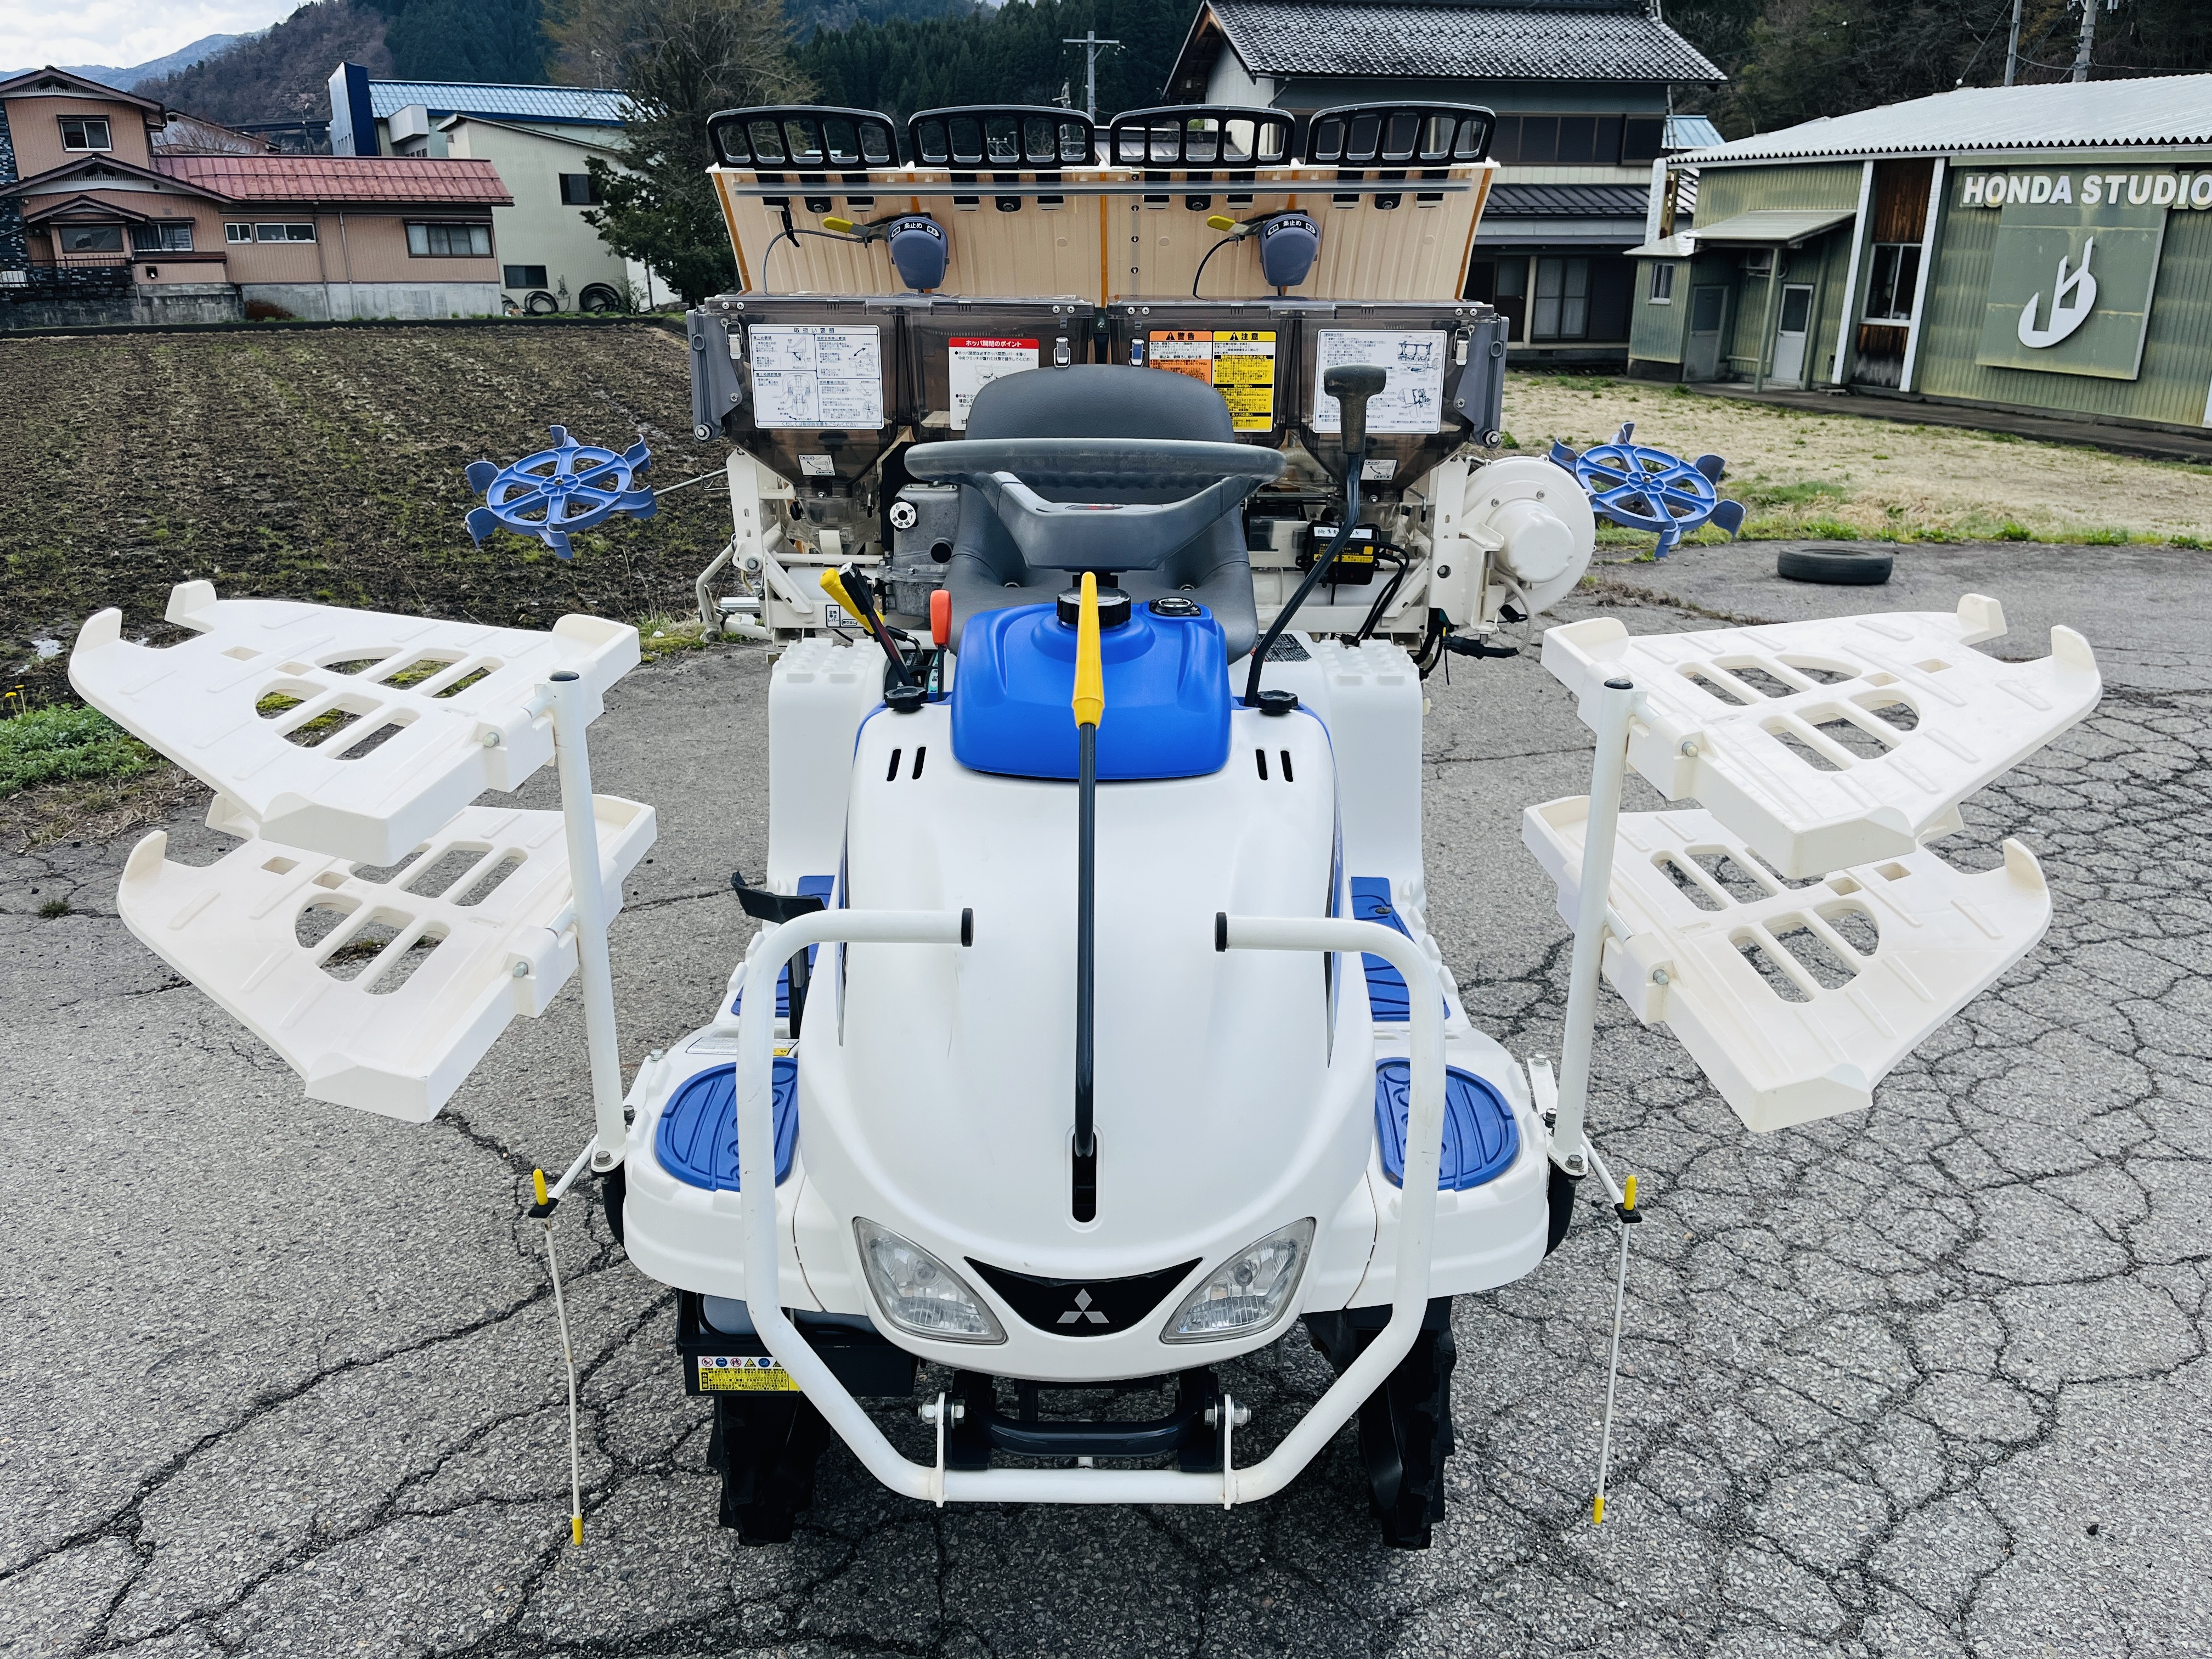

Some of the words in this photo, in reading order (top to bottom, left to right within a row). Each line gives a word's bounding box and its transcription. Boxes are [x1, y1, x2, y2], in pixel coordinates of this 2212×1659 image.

[1962, 174, 2073, 205] HONDA
[2080, 174, 2212, 206] STUDIO
[1177, 332, 1195, 340] 警告
